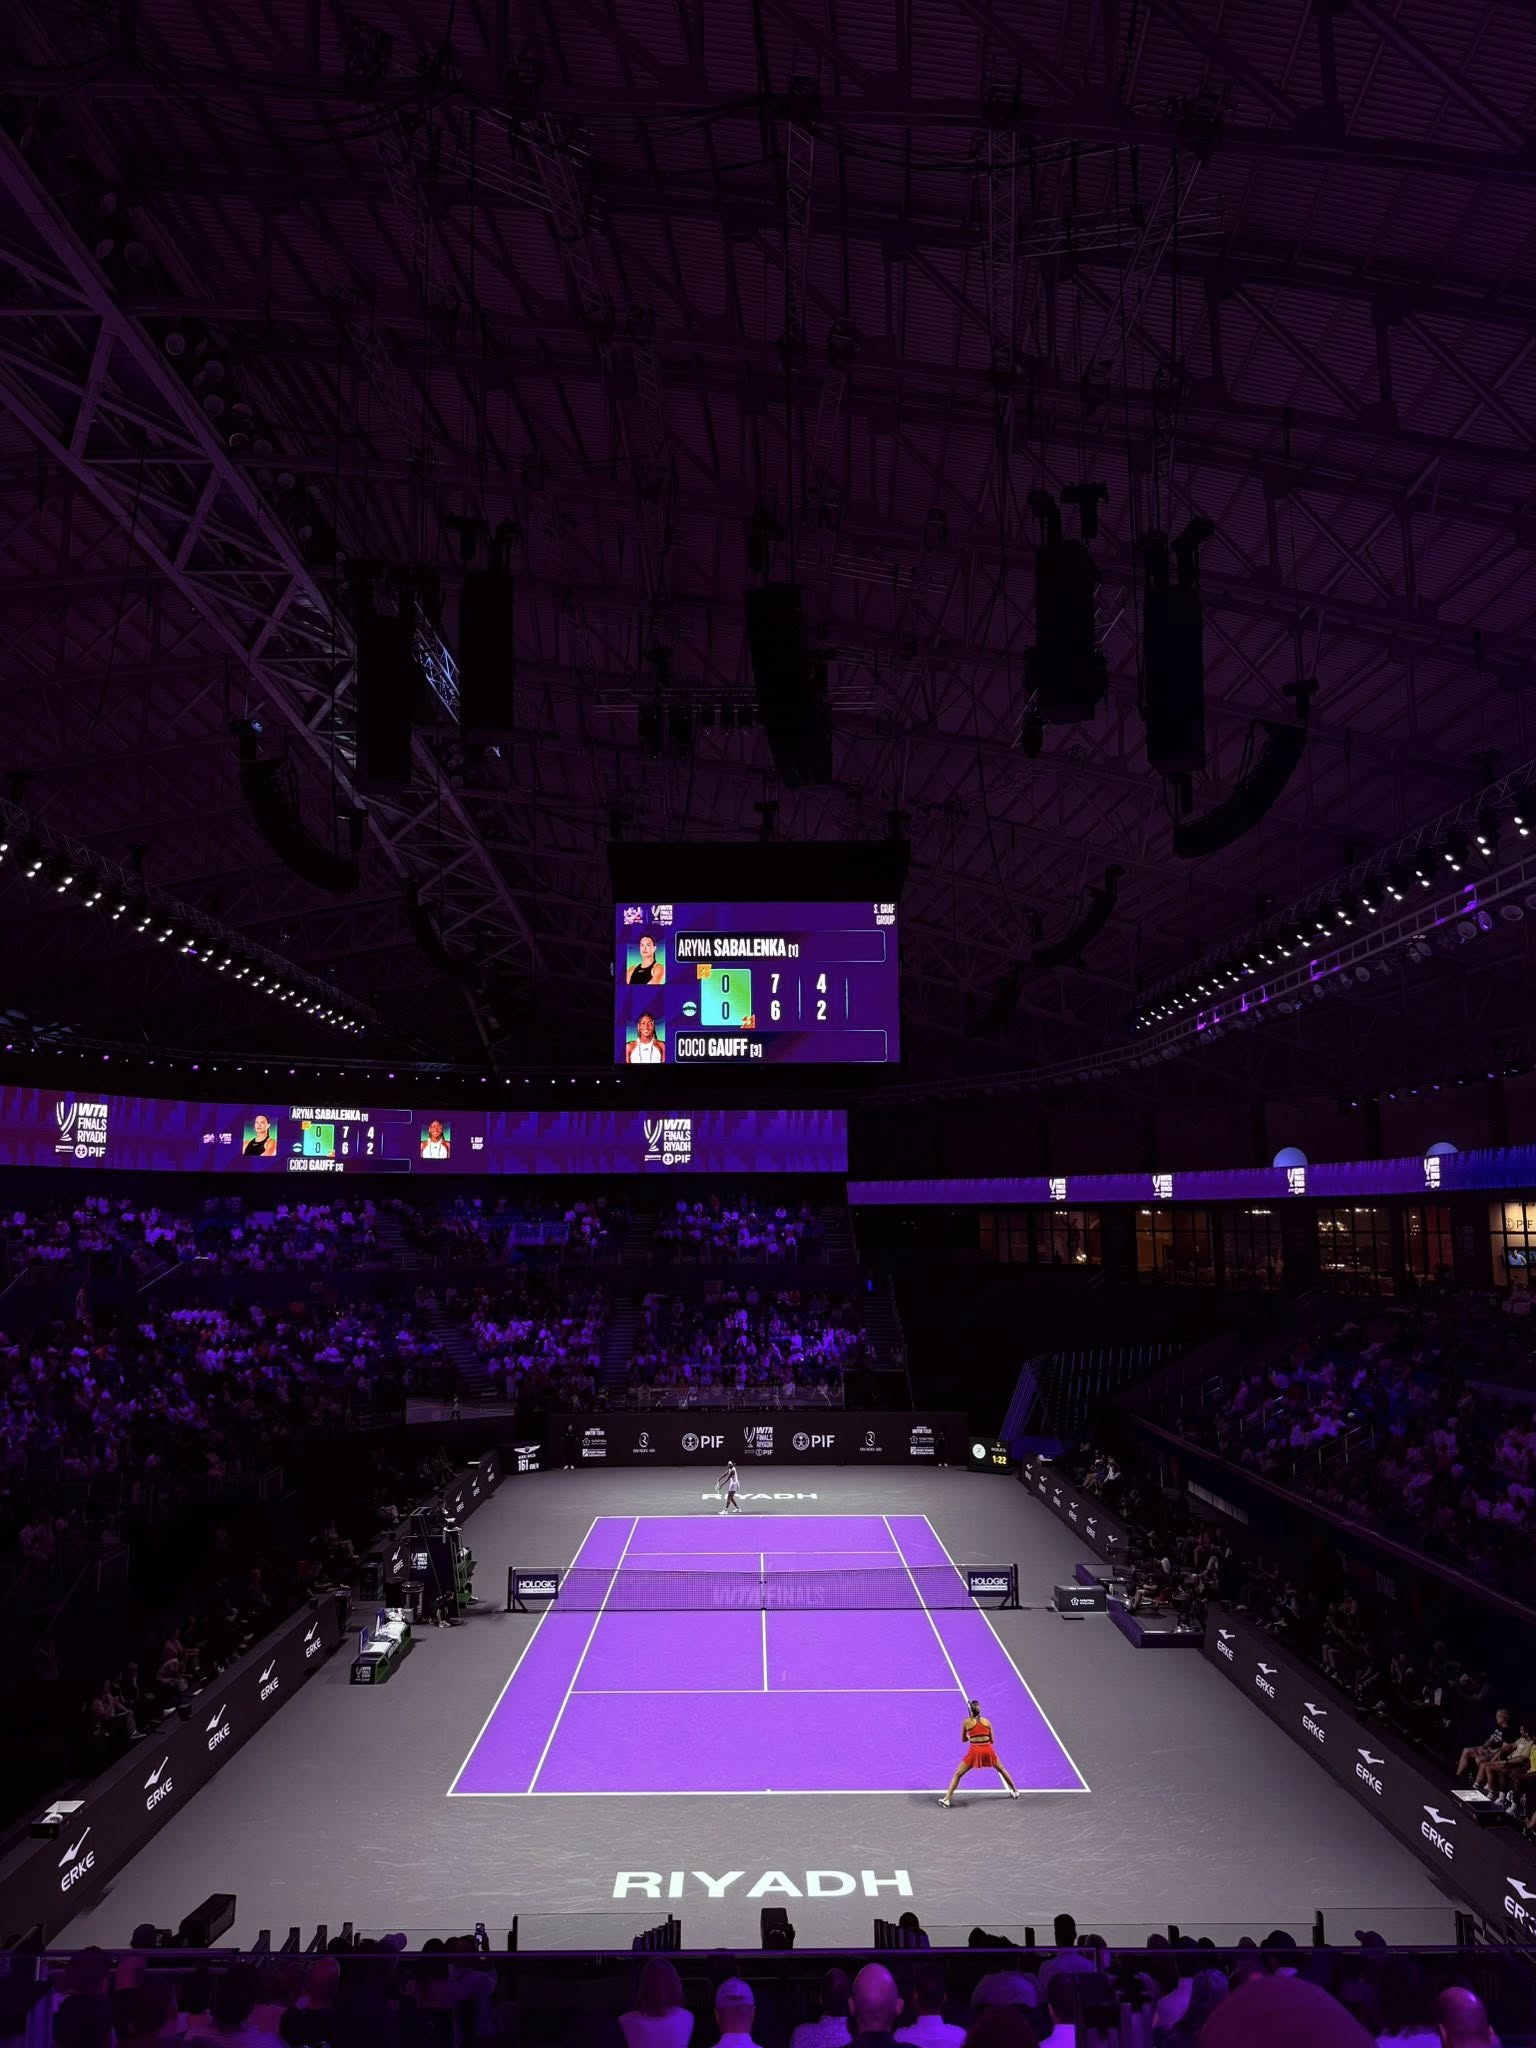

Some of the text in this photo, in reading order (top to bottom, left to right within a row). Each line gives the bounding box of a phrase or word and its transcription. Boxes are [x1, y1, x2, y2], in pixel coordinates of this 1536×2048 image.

[876, 915, 895, 925] GROUP
[678, 939, 799, 958] ARYNA SABALENKA [1]
[722, 974, 827, 993] 0 7 4
[722, 1000, 827, 1020] 0 6 2
[678, 1039, 762, 1058] COCO GAUFF [3]
[79, 1103, 108, 1118] WTA
[292, 1107, 313, 1119] ARYNA
[315, 1108, 360, 1120] SABALENKA
[78, 1118, 107, 1131] FINALS
[664, 1119, 691, 1130] WTA
[77, 1131, 107, 1143] RIYADH
[343, 1126, 350, 1139] 7
[367, 1126, 375, 1139] 4
[664, 1130, 691, 1141] FINALS
[88, 1147, 106, 1158] PIF
[342, 1142, 349, 1154] 6
[367, 1142, 374, 1154] 2
[664, 1142, 691, 1151] RIYADH
[289, 1160, 308, 1171] COCO
[309, 1160, 335, 1171] GAUFF
[675, 1155, 691, 1163] PIF
[756, 1426, 773, 1434] WTA
[700, 1435, 724, 1448] PIF
[811, 1435, 835, 1448] PIF
[518, 1459, 529, 1472] 161
[519, 1580, 556, 1588] HOLOGIC
[970, 1577, 1008, 1585] HOLOGIC
[306, 1637, 322, 1658] ERKE
[1217, 1640, 1234, 1661] ERKE
[260, 1676, 280, 1700] ERKE
[1255, 1674, 1276, 1698] ERKE
[1302, 1715, 1325, 1743] ERKE
[208, 1722, 230, 1751] ERKE
[1355, 1763, 1383, 1795] ERKE
[146, 1777, 173, 1811] ERKE
[1421, 1821, 1454, 1860] ERKE
[61, 1851, 96, 1892] ERKE
[612, 1870, 914, 1898] RIYADH
